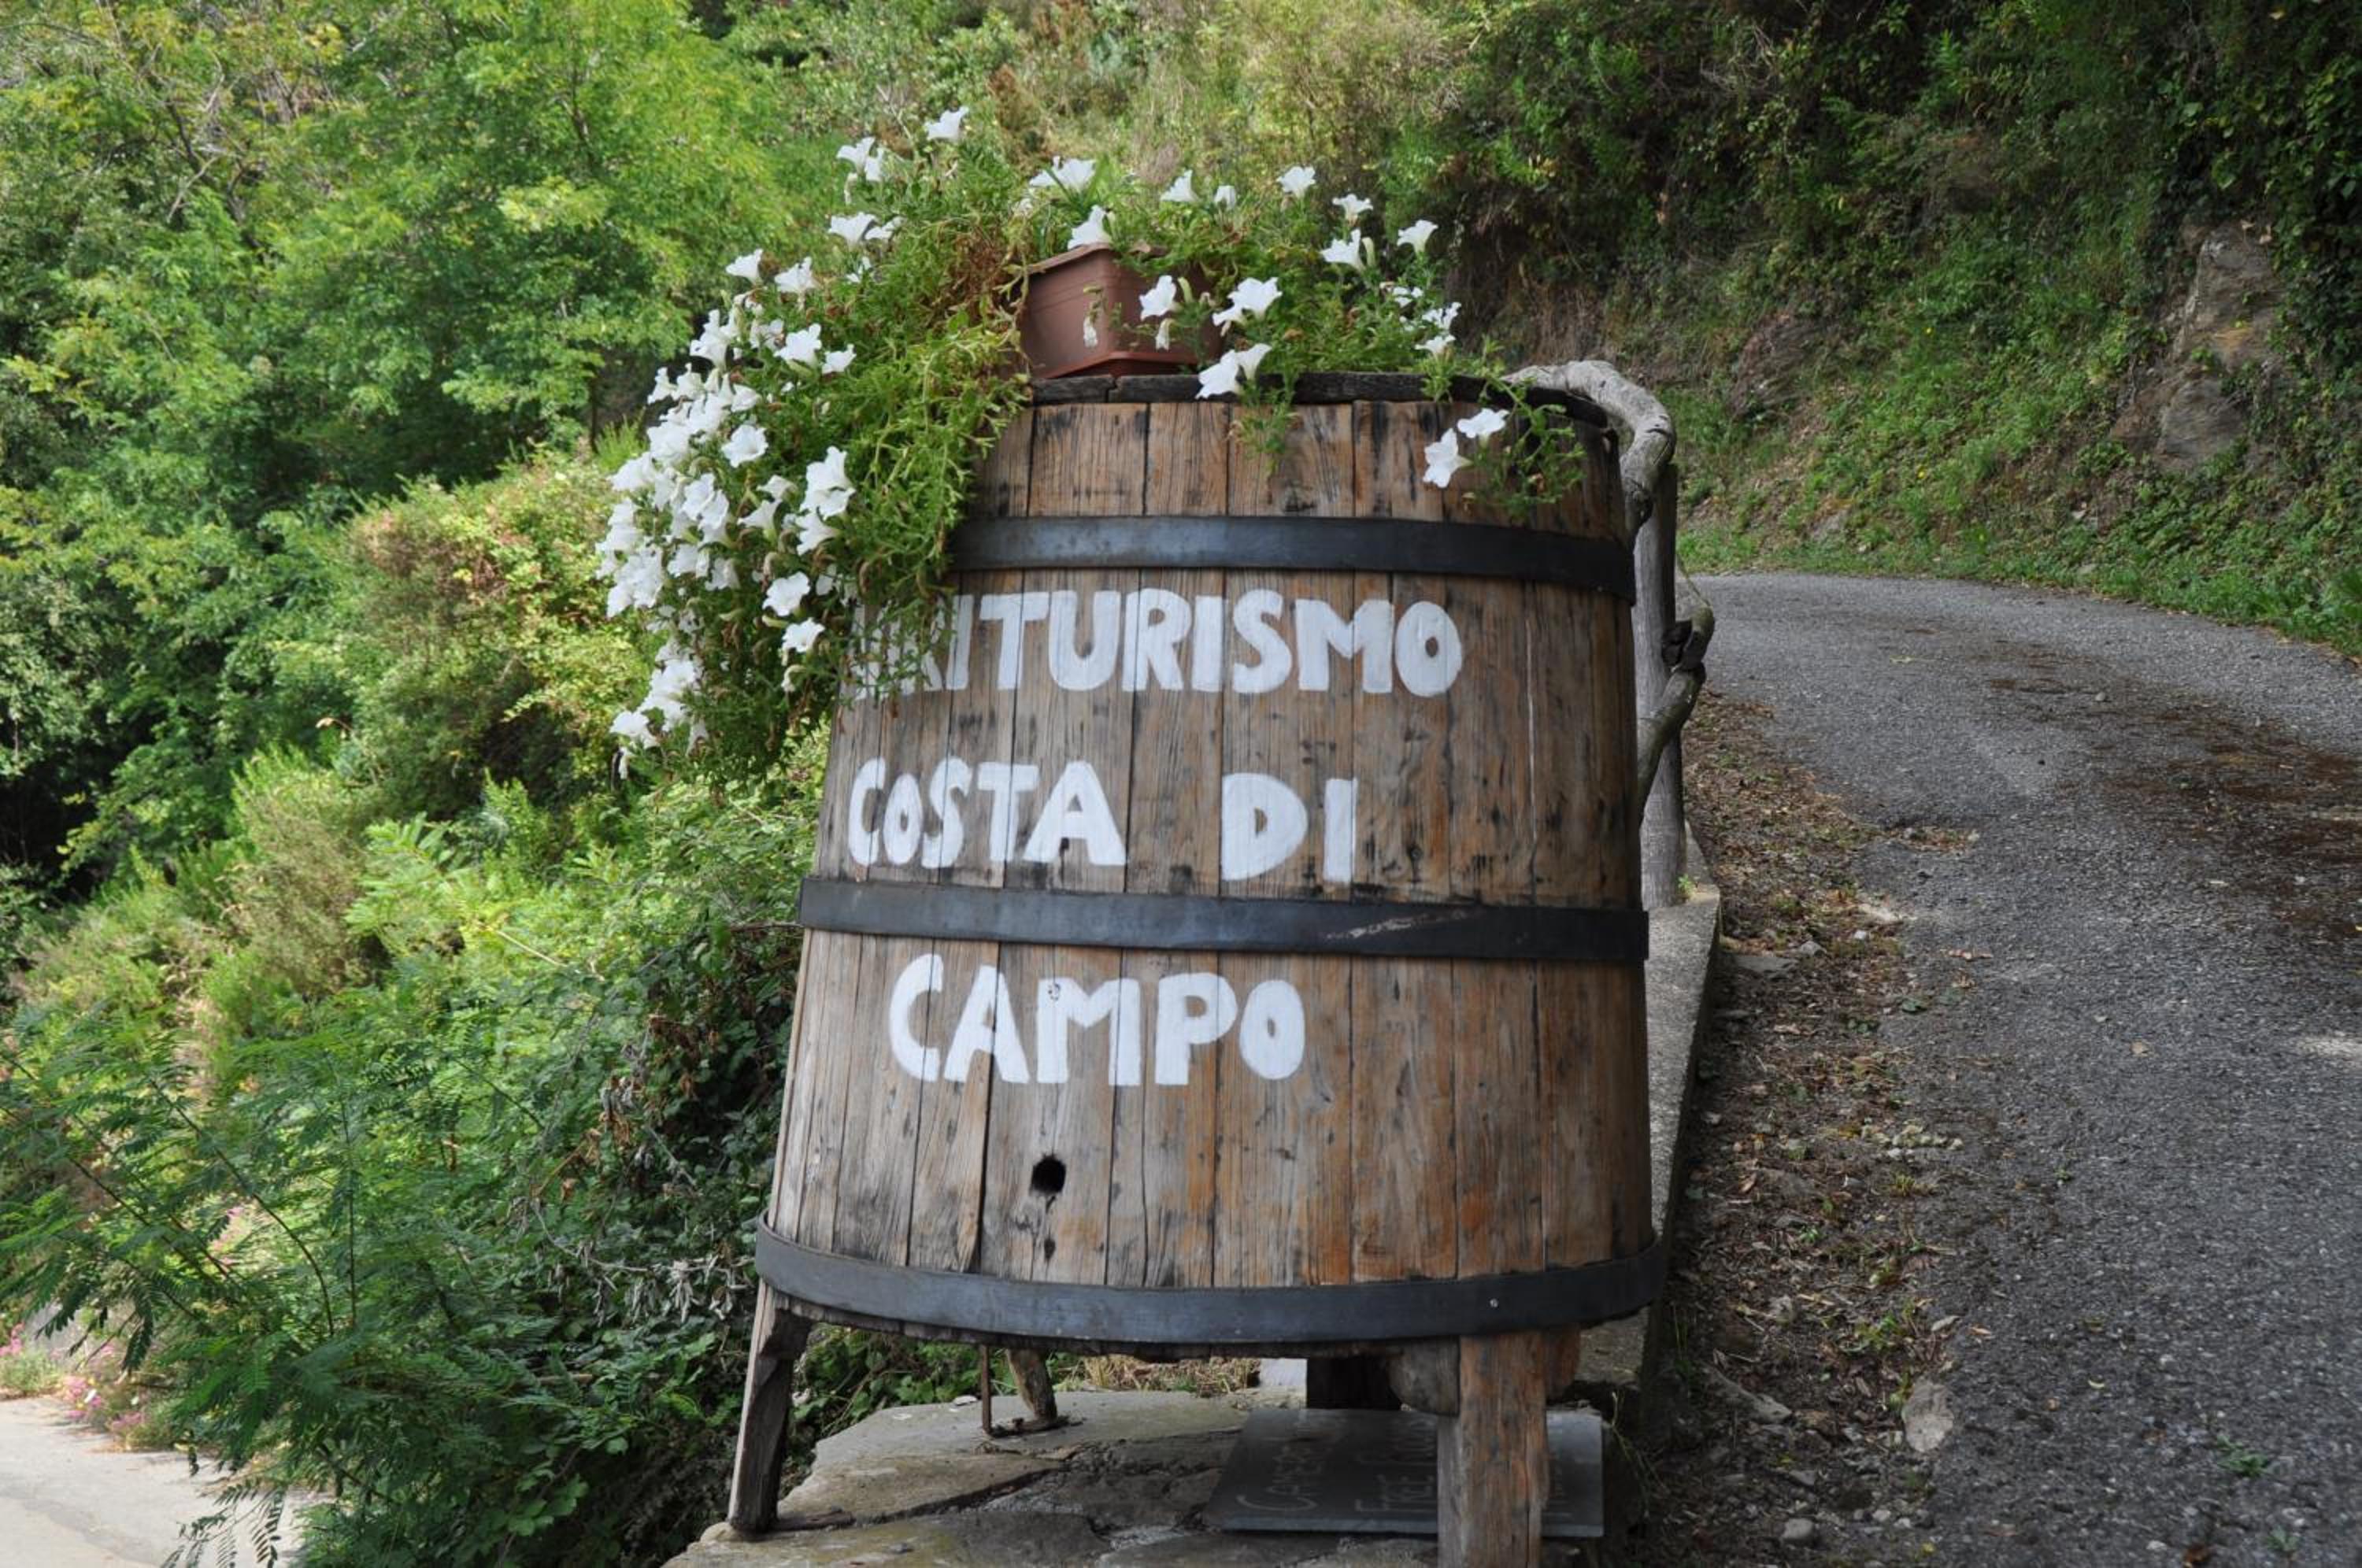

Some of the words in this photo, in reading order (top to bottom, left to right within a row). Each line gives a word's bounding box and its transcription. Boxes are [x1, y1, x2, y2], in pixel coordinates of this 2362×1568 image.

[846, 755, 1127, 870] COSTA
[1220, 773, 1357, 883] DI
[888, 953, 1306, 1086] CAMPO
